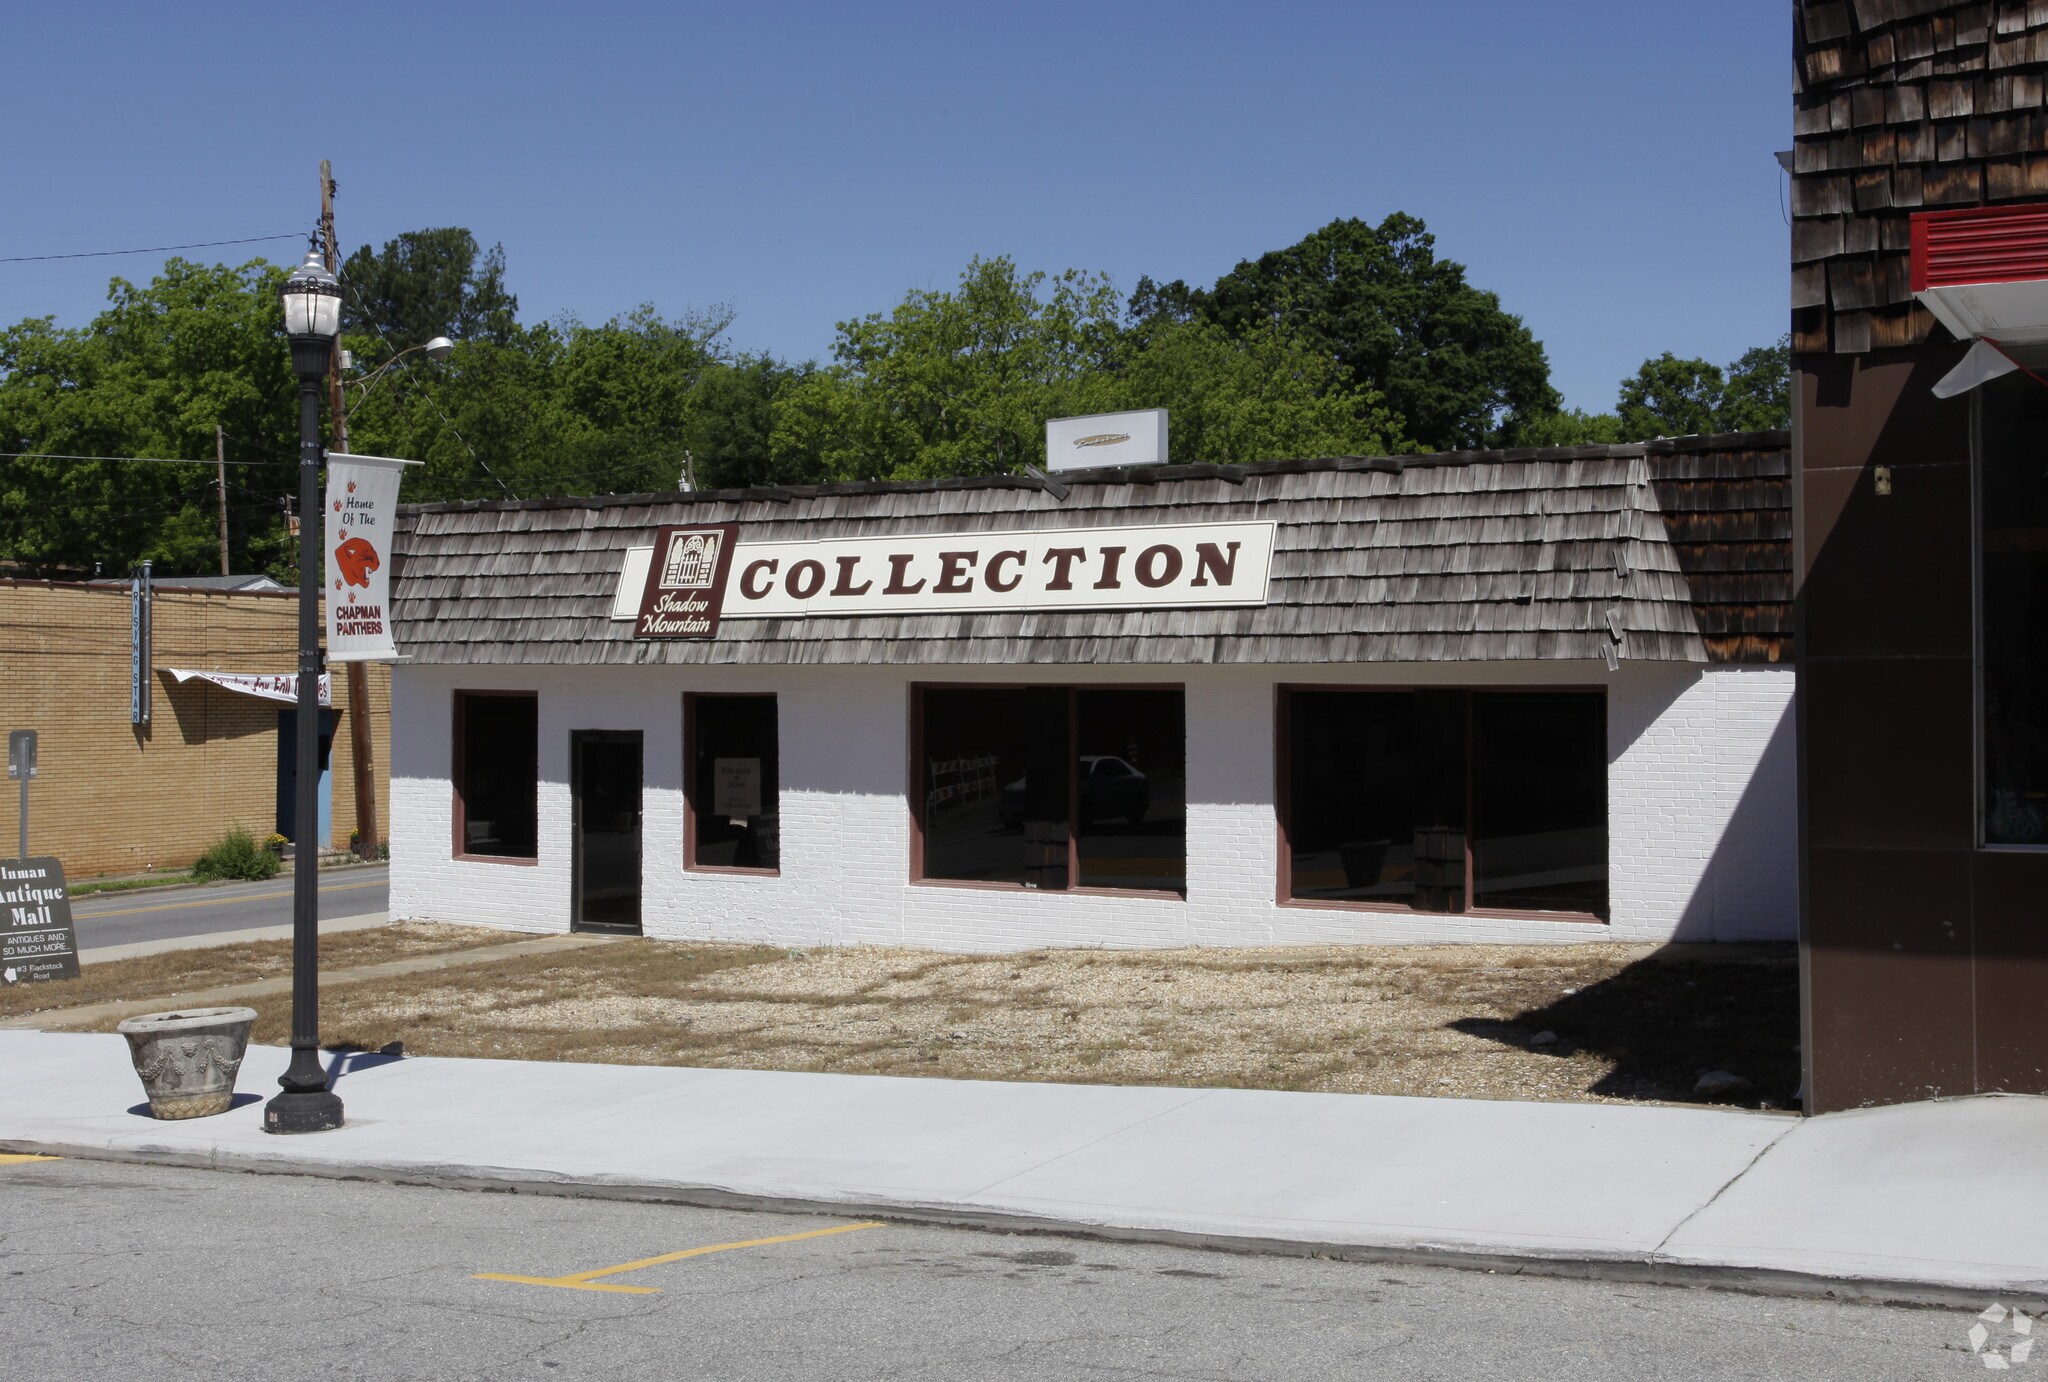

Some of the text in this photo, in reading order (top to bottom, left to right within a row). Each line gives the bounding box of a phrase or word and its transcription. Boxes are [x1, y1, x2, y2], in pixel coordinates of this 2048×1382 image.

[346, 496, 375, 510] Home
[342, 512, 376, 526] Of The
[739, 541, 1241, 600] COLLECTION
[653, 590, 709, 613] Shadow
[336, 605, 382, 620] CHAPMAN
[336, 620, 383, 637] PANTHERS
[641, 613, 711, 633] Mountain
[1, 866, 47, 880] Inman
[0, 883, 64, 905] Antique
[11, 906, 52, 926] Mall
[7, 934, 46, 945] ANTIQUES
[3, 946, 15, 956] SO
[17, 944, 42, 954] MUCH
[33, 972, 51, 980] Road
